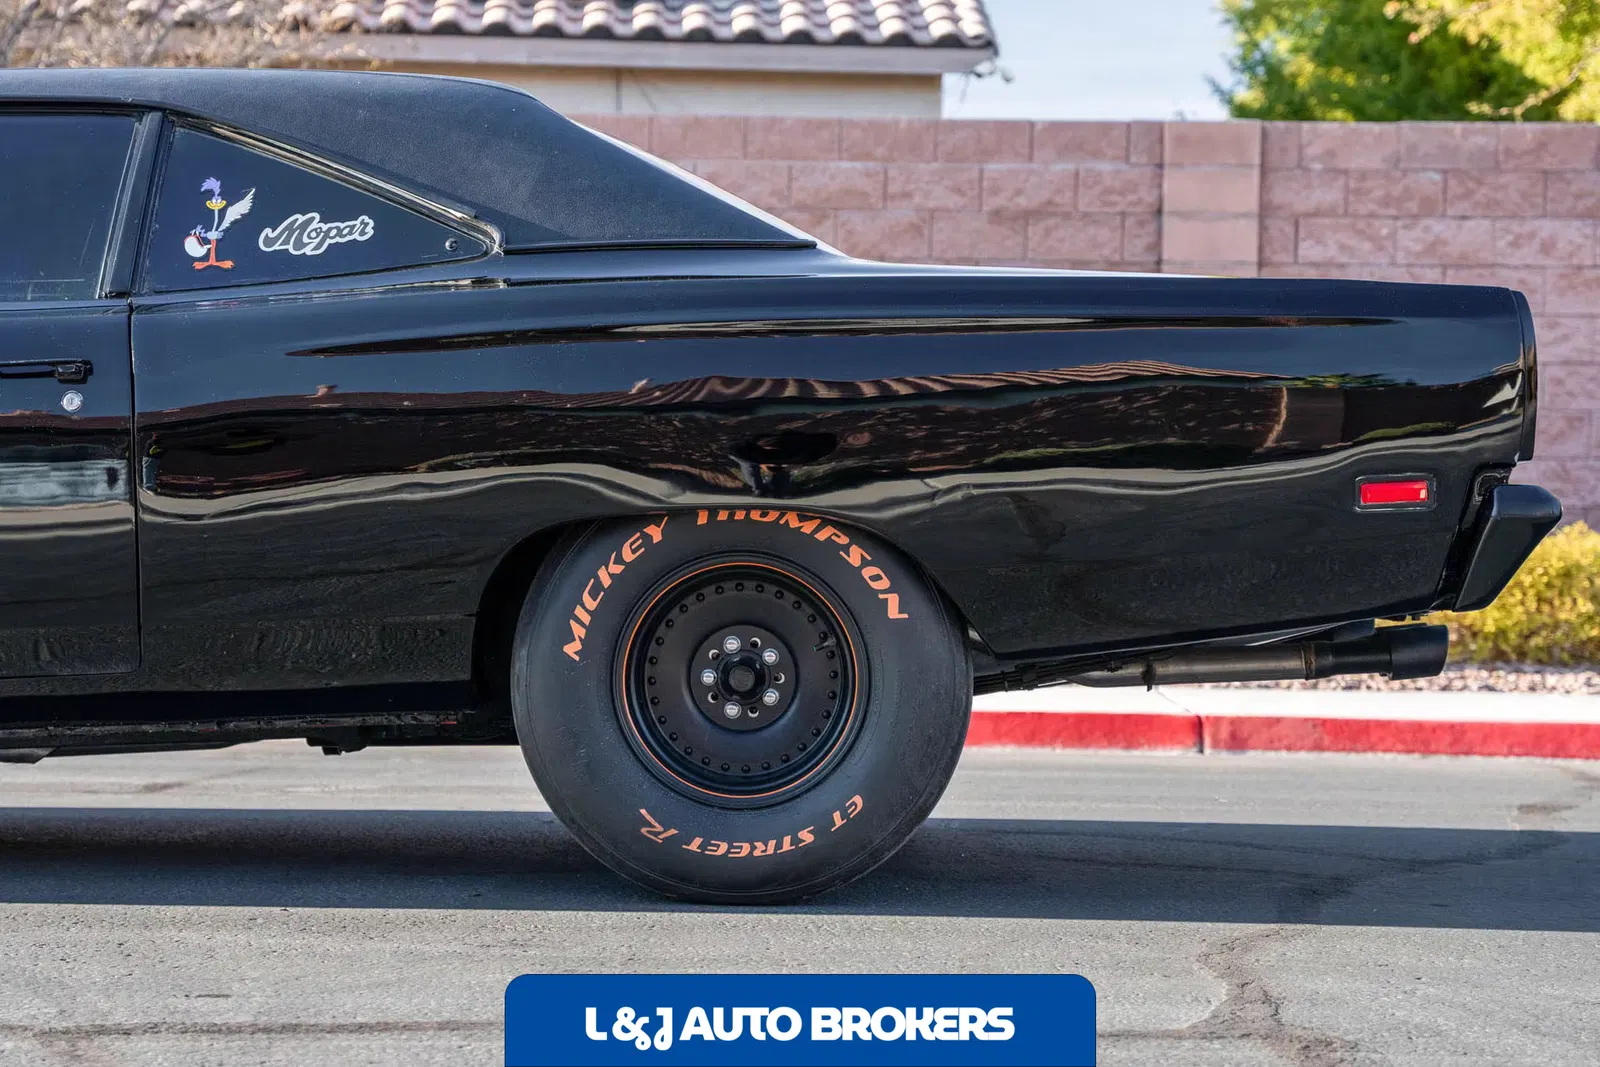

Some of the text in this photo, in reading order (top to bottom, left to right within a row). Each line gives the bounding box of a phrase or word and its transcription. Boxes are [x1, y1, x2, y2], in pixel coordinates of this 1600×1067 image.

[258, 212, 375, 256] Mopar
[562, 516, 669, 662] MICKEY
[831, 794, 864, 832] ET
[681, 826, 815, 858] STREET
